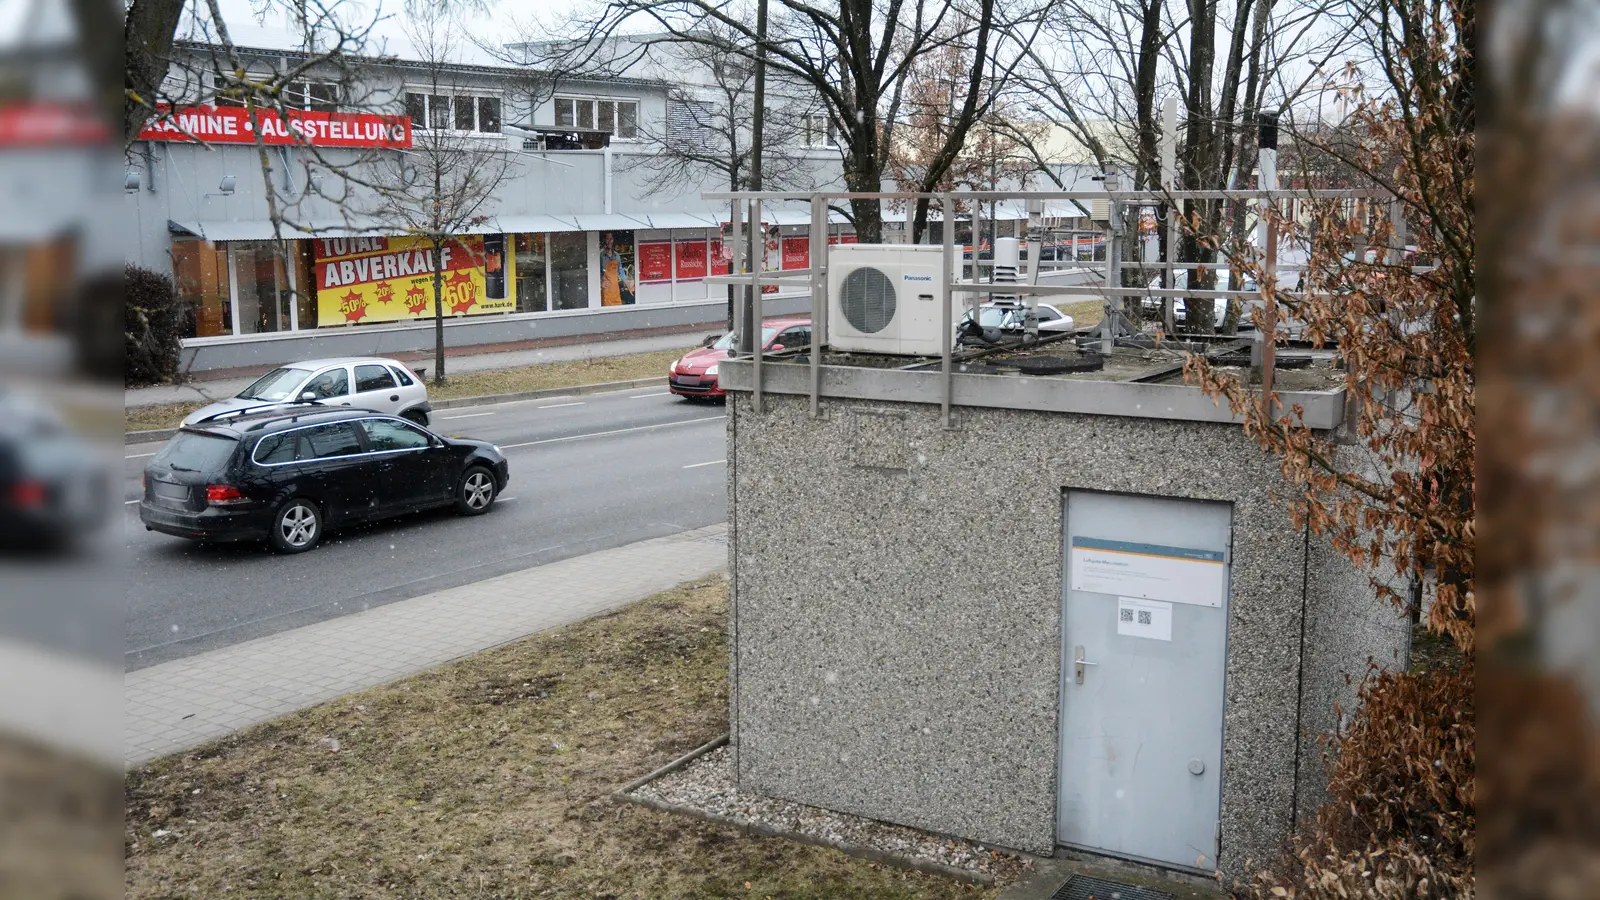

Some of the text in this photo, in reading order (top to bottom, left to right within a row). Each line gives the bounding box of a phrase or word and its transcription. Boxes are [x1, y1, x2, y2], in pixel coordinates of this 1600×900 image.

[262, 117, 405, 142] AUSSTELLUNG
[341, 299, 366, 315] 50%
[446, 281, 482, 308] 60%
